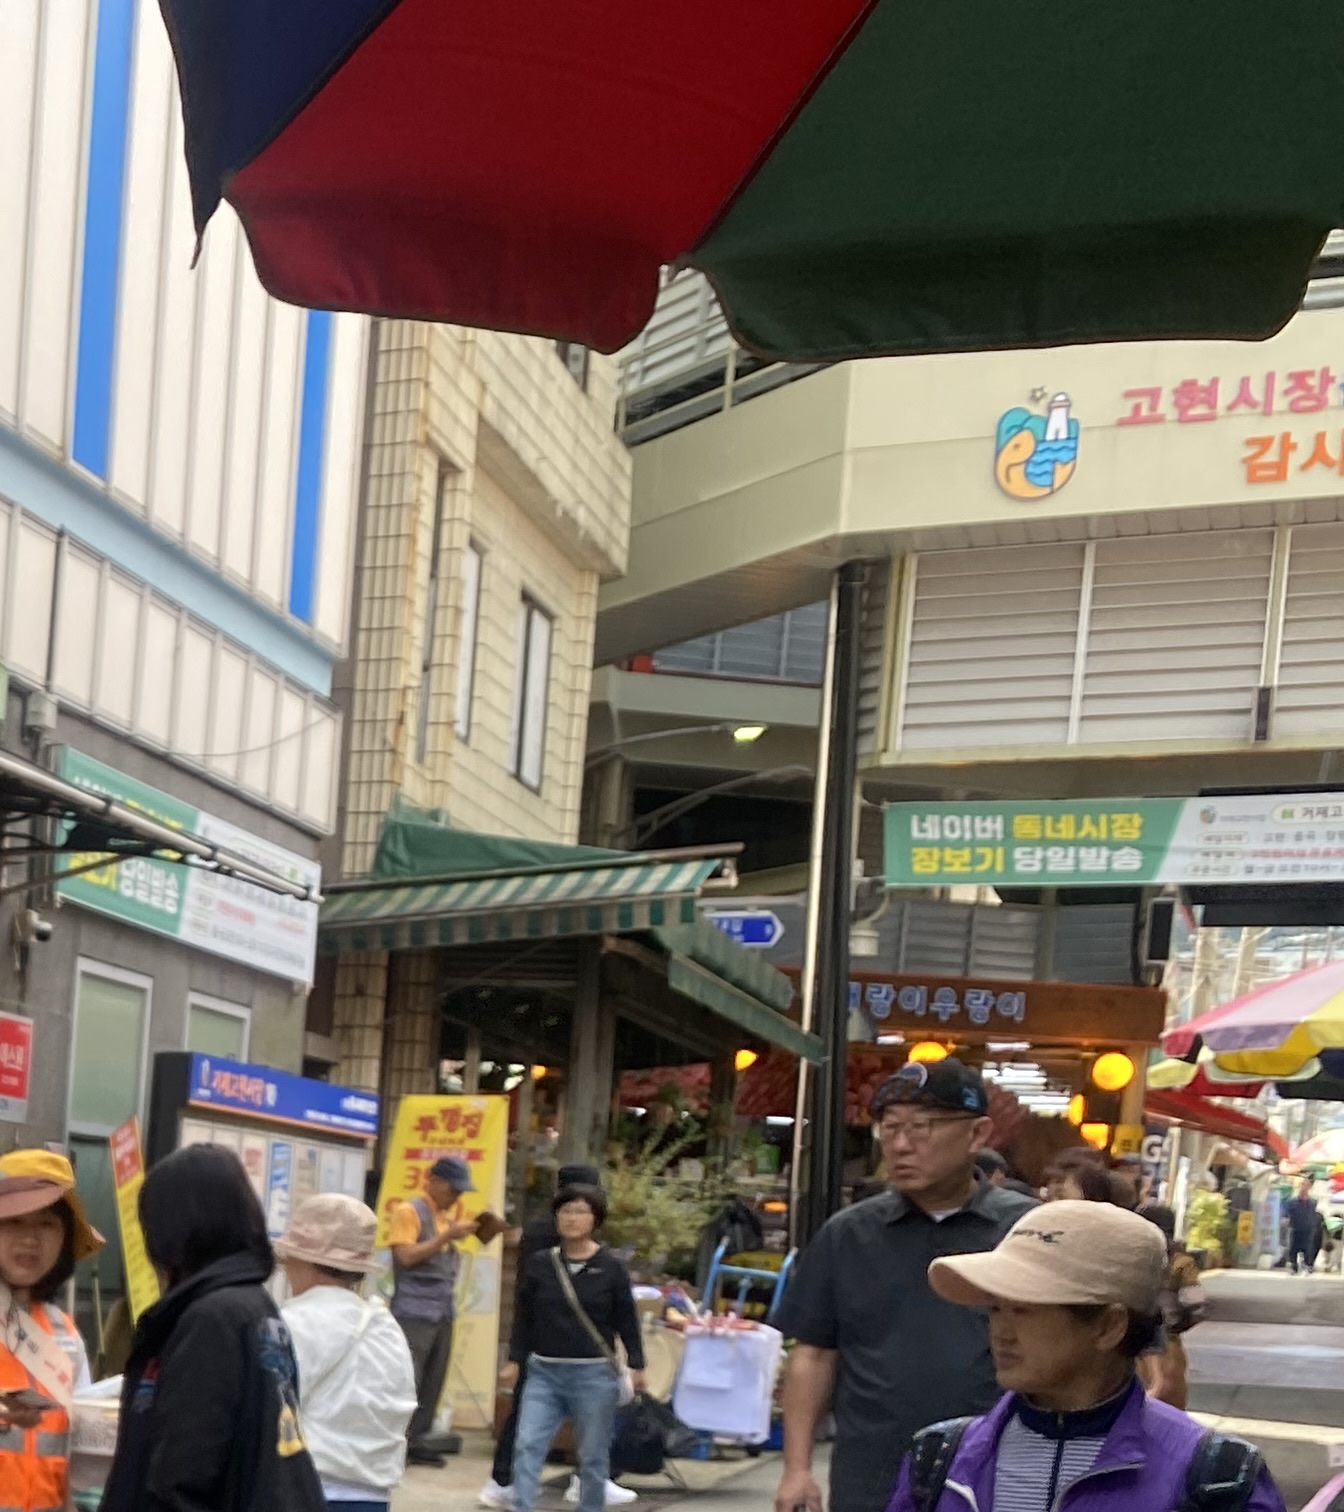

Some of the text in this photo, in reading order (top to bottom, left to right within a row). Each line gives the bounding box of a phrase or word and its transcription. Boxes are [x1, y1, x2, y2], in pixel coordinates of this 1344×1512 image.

[1116, 365, 1337, 427] 고현시장
[911, 812, 1144, 842] 네이버 동네시장
[911, 846, 1144, 874] 장보기 당일발송
